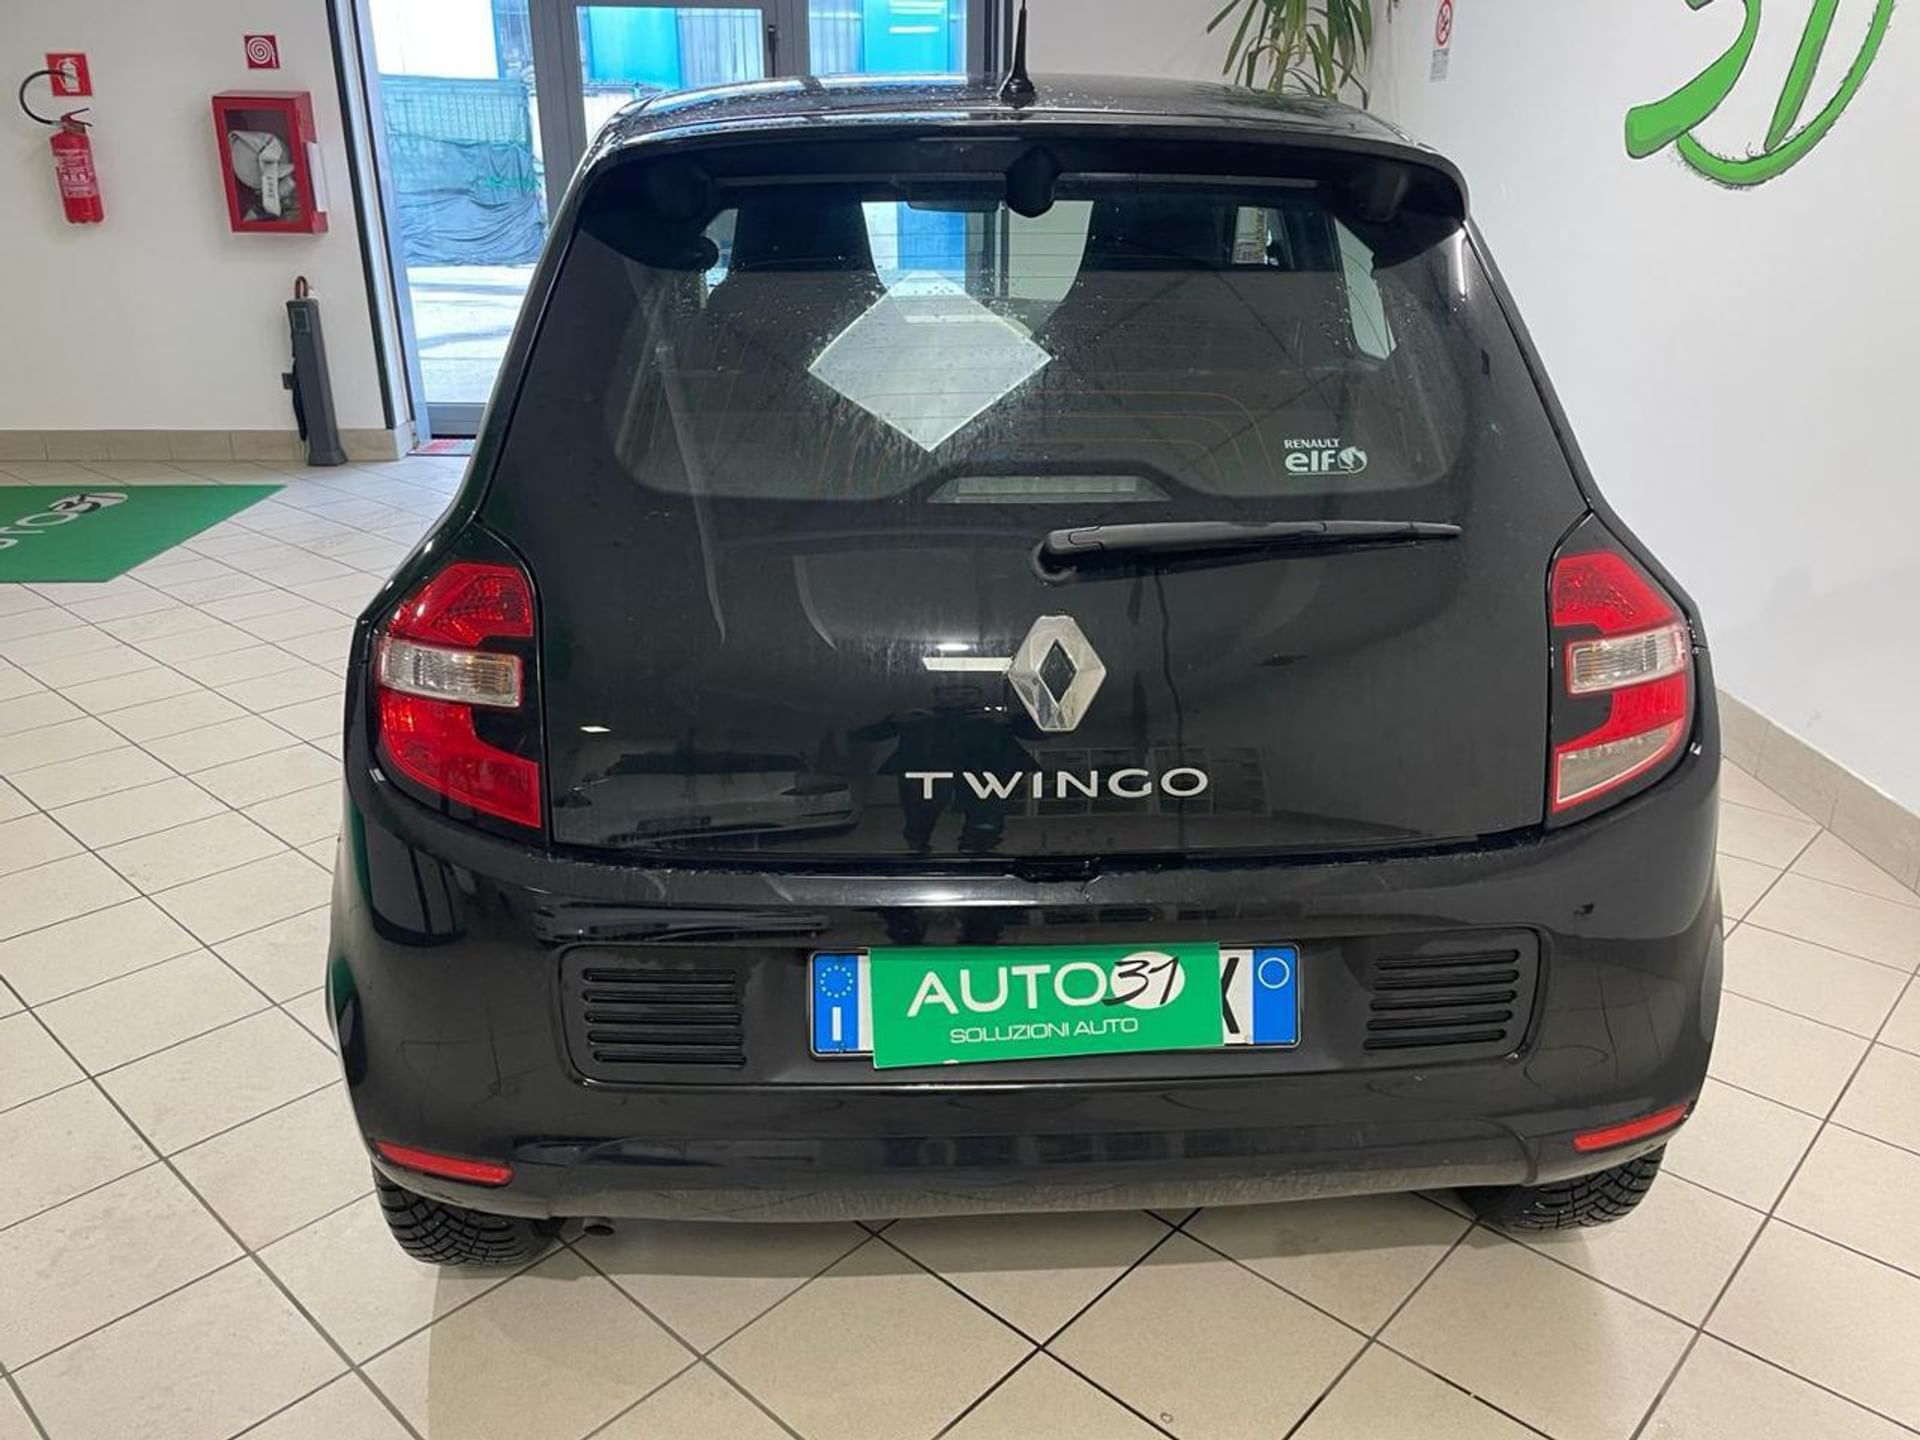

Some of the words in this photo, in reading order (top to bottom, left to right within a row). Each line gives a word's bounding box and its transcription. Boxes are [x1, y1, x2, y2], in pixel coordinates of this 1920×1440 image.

[1284, 438, 1340, 449] RENAULT
[1284, 450, 1336, 473] elf
[904, 767, 1210, 800] TWINGO
[949, 1022, 1070, 1044] SOLUZIONI
[1073, 1017, 1140, 1035] AUTO
